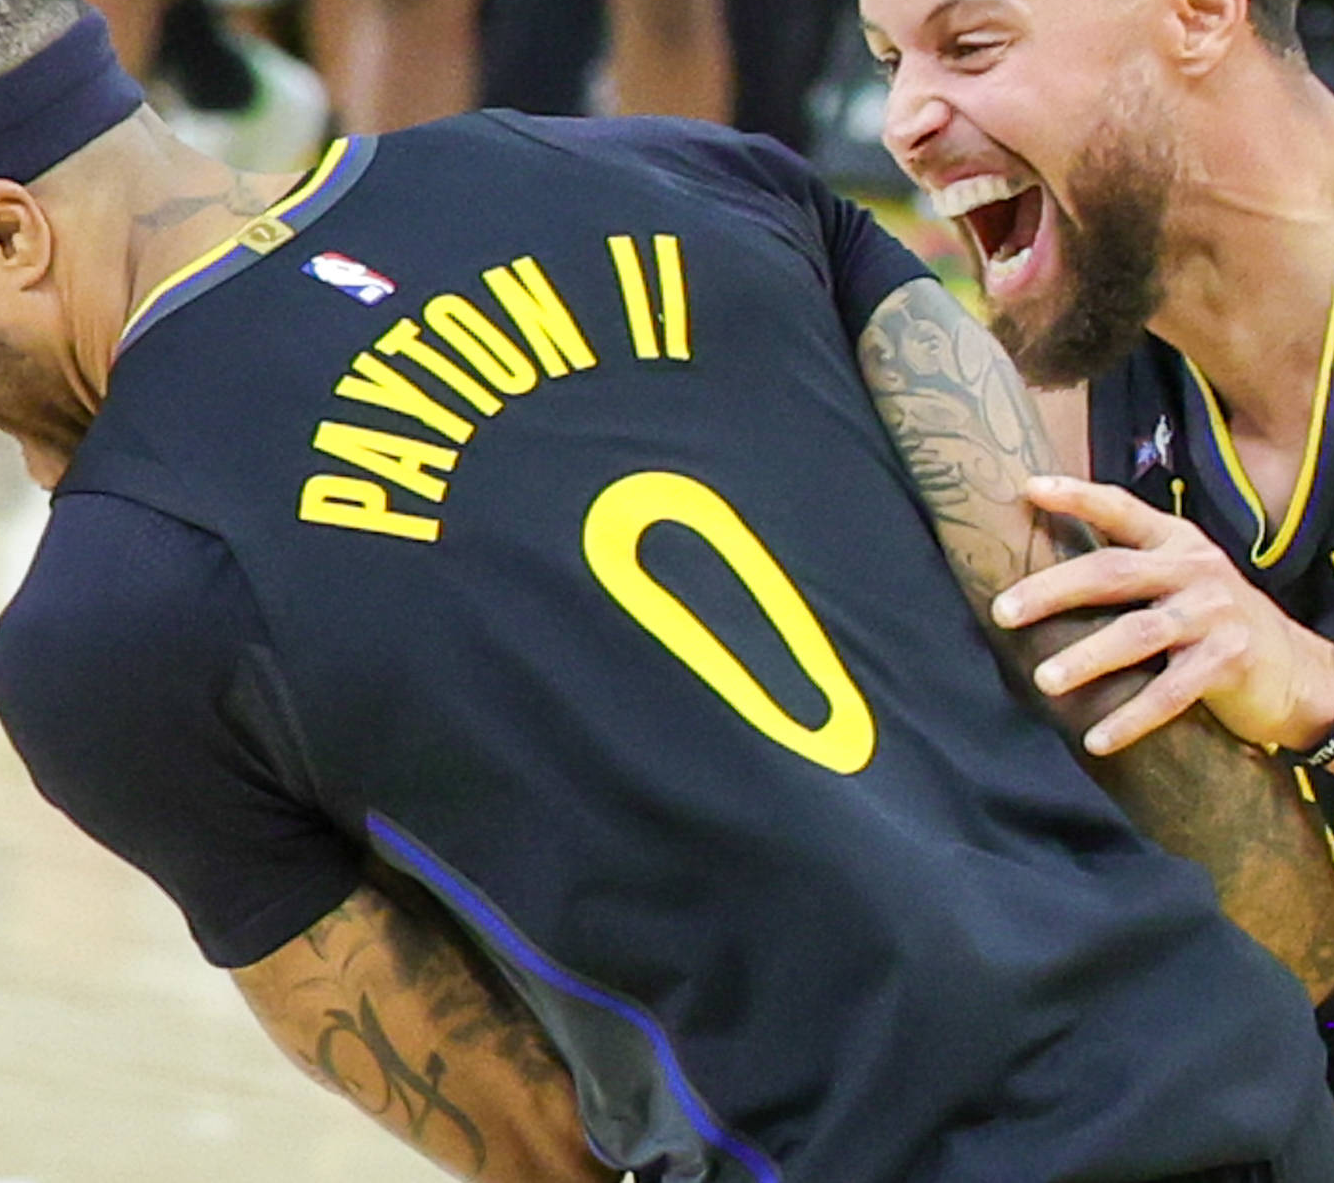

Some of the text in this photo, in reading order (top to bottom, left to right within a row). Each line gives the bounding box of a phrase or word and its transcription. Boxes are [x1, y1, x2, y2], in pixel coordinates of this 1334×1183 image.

[299, 234, 691, 542] PAYTON II
[583, 471, 877, 775] 0
